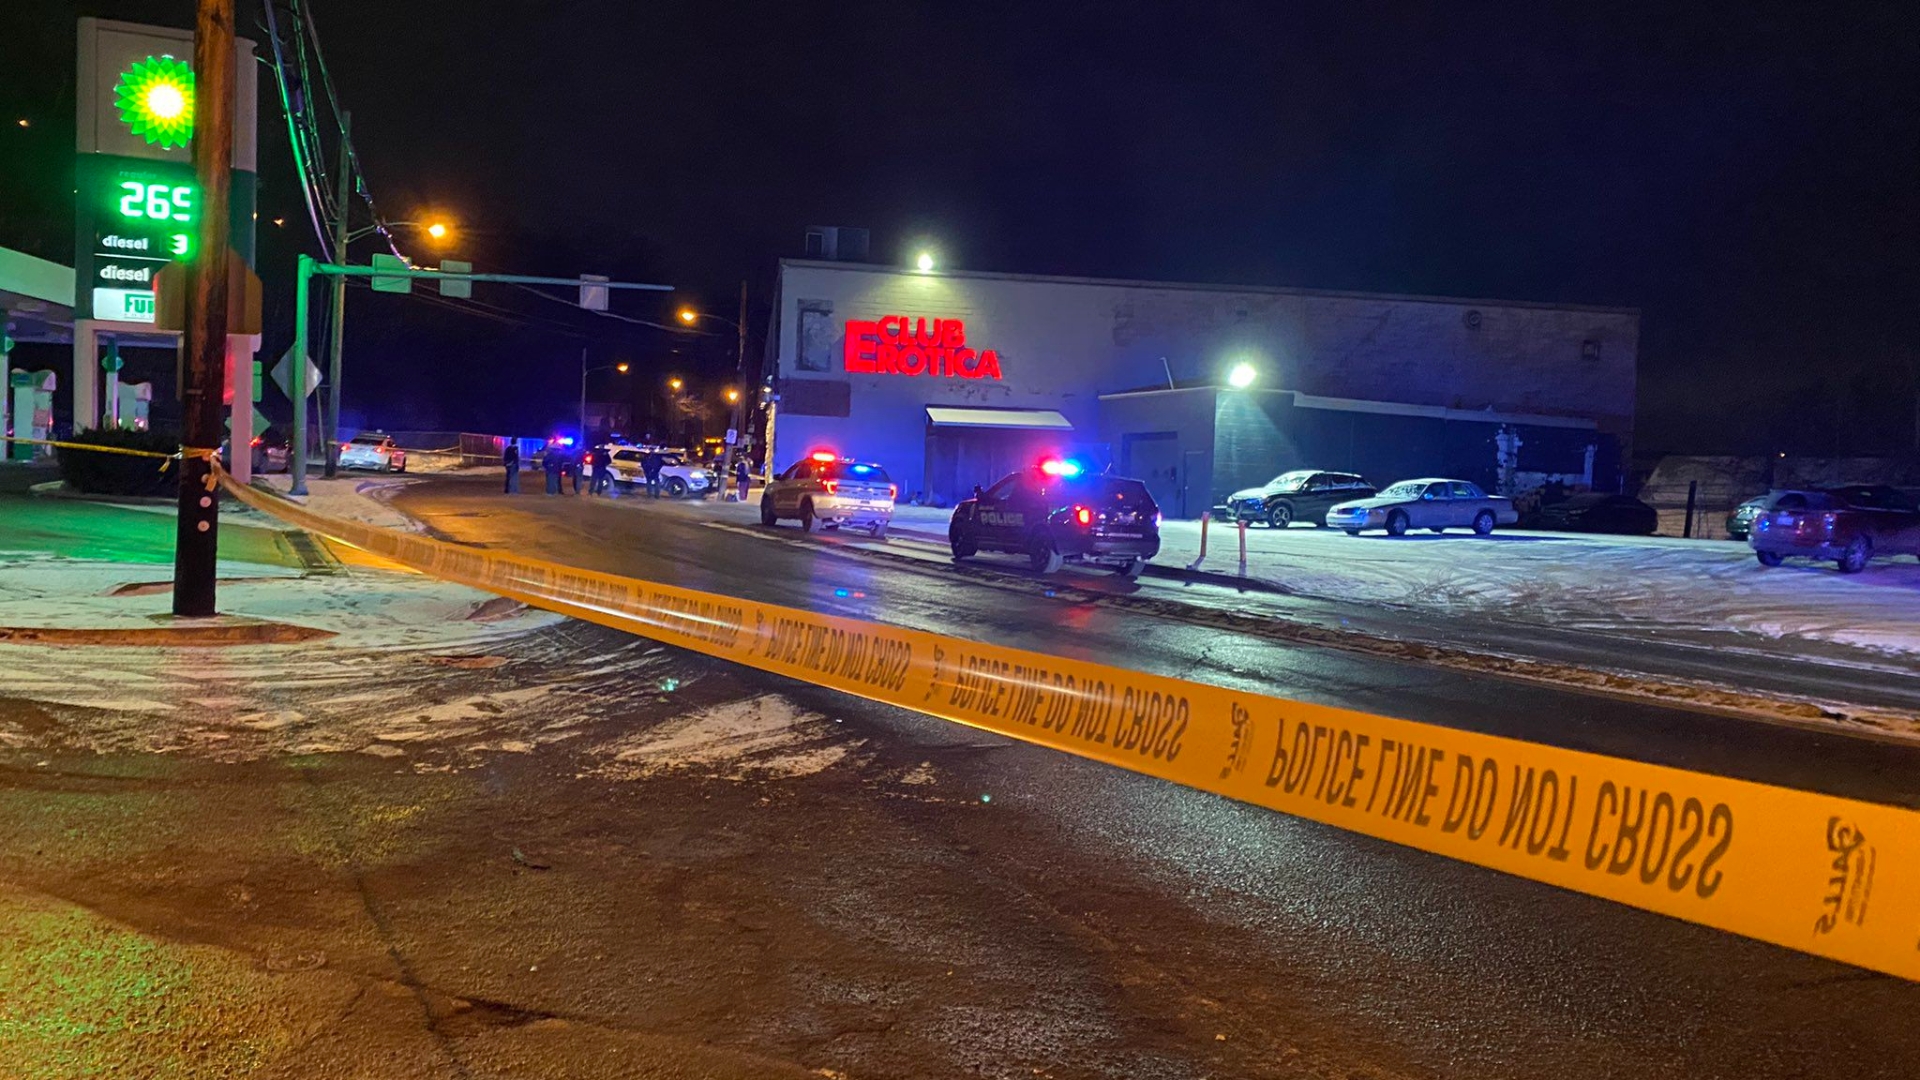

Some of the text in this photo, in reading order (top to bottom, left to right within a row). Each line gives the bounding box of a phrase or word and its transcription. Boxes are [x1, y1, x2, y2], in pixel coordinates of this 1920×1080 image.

[102, 235, 148, 250] diesel
[100, 265, 149, 281] diesel
[877, 315, 966, 348] CLUB
[844, 320, 1002, 380] EROTICA
[980, 512, 1024, 526] POLICE
